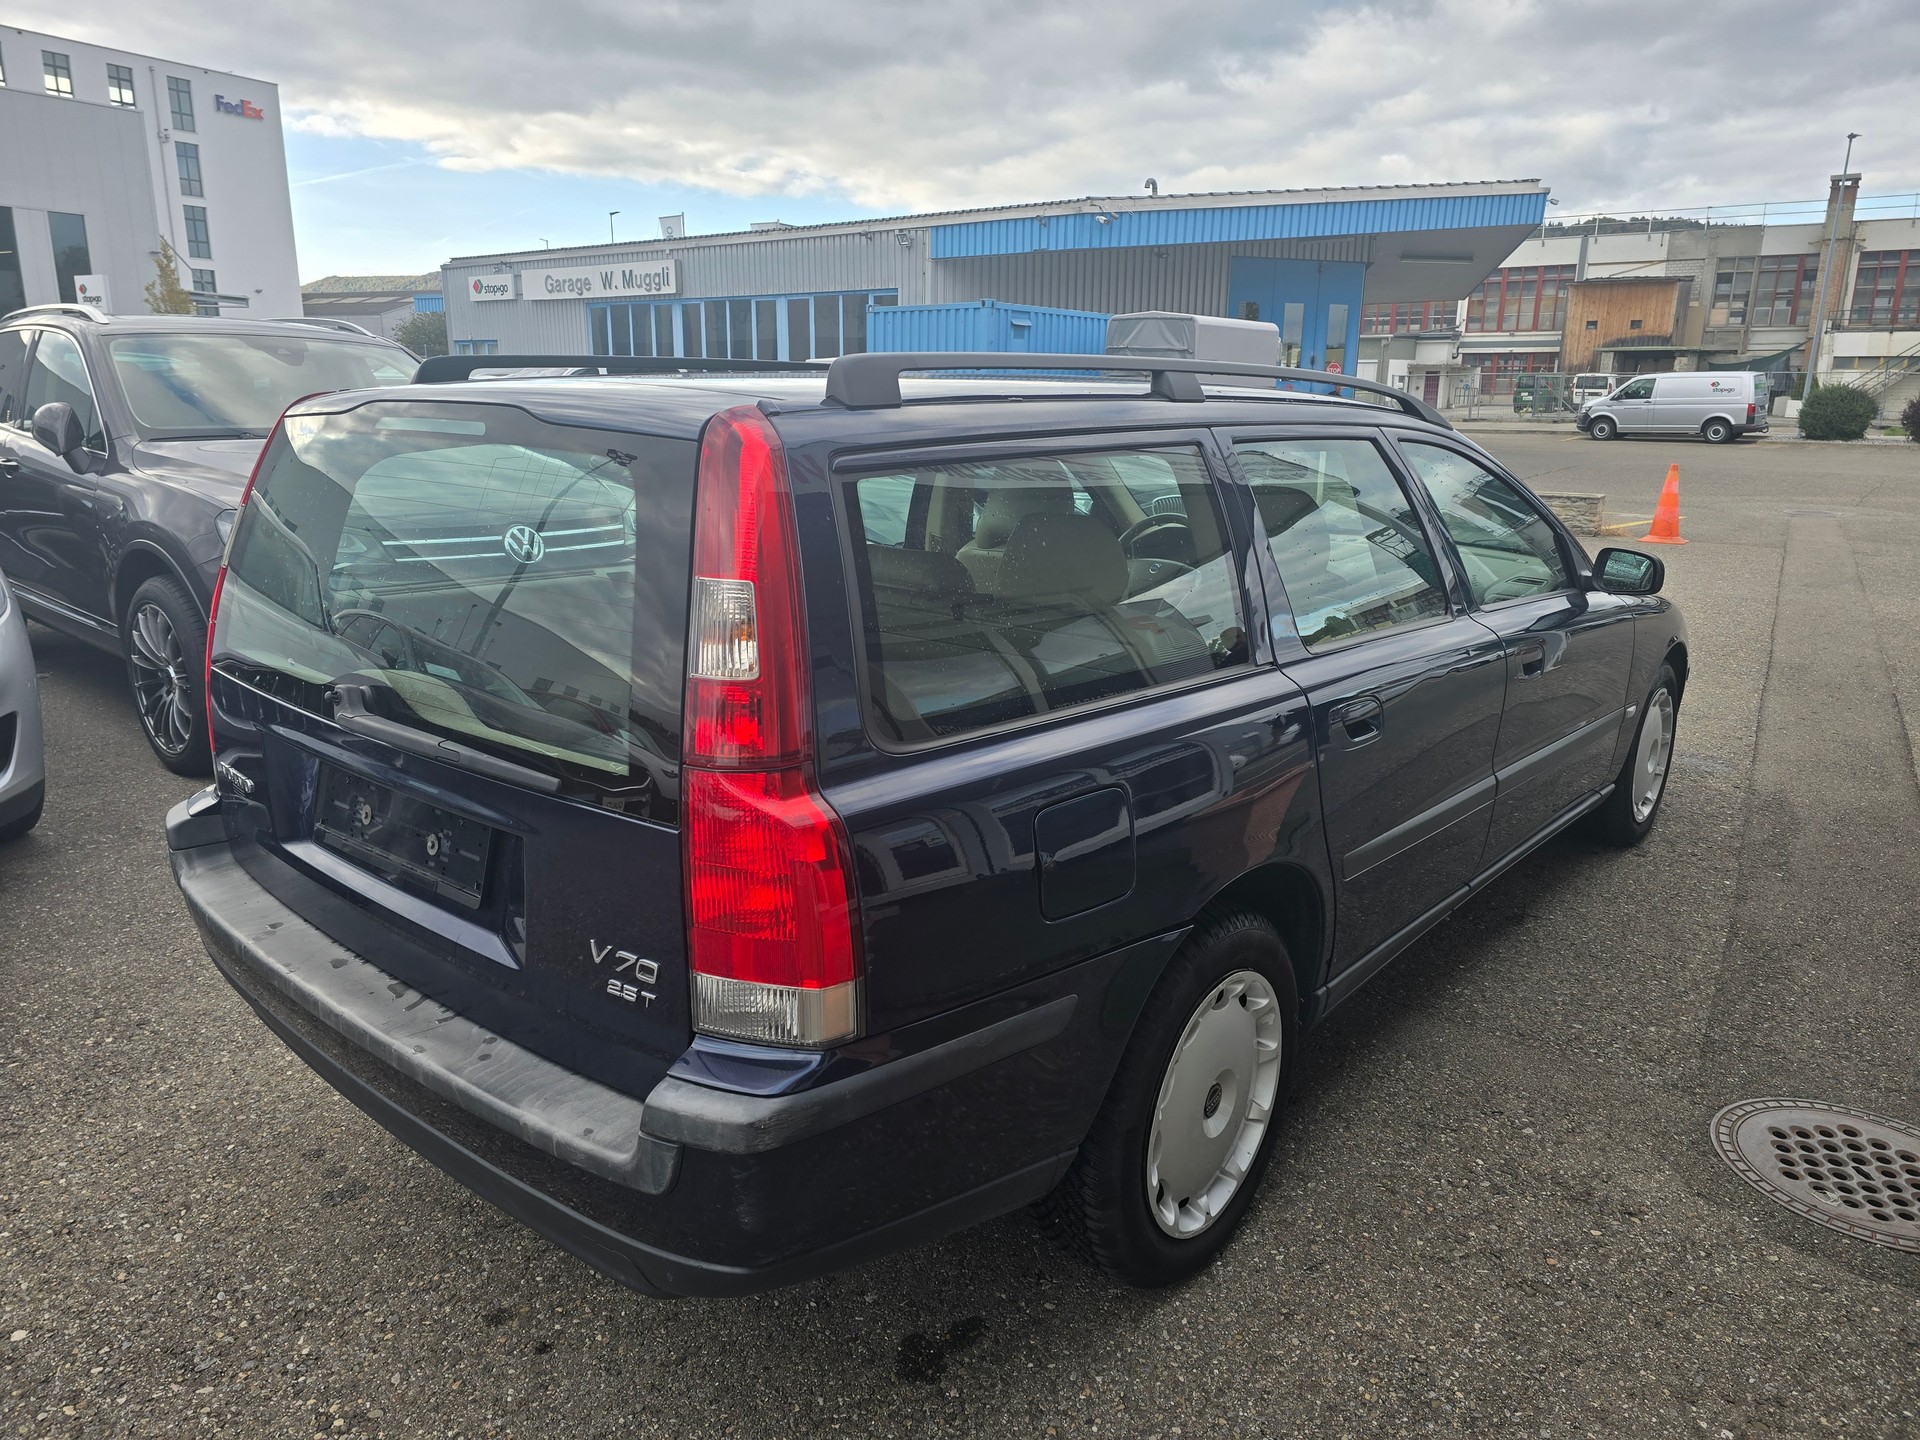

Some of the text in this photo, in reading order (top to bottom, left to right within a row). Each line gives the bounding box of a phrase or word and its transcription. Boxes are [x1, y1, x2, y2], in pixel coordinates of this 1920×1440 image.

[215, 94, 264, 120] FedEx
[484, 284, 508, 296] stop+go
[544, 266, 670, 296] Garage W. Muggli
[590, 939, 659, 985] V70
